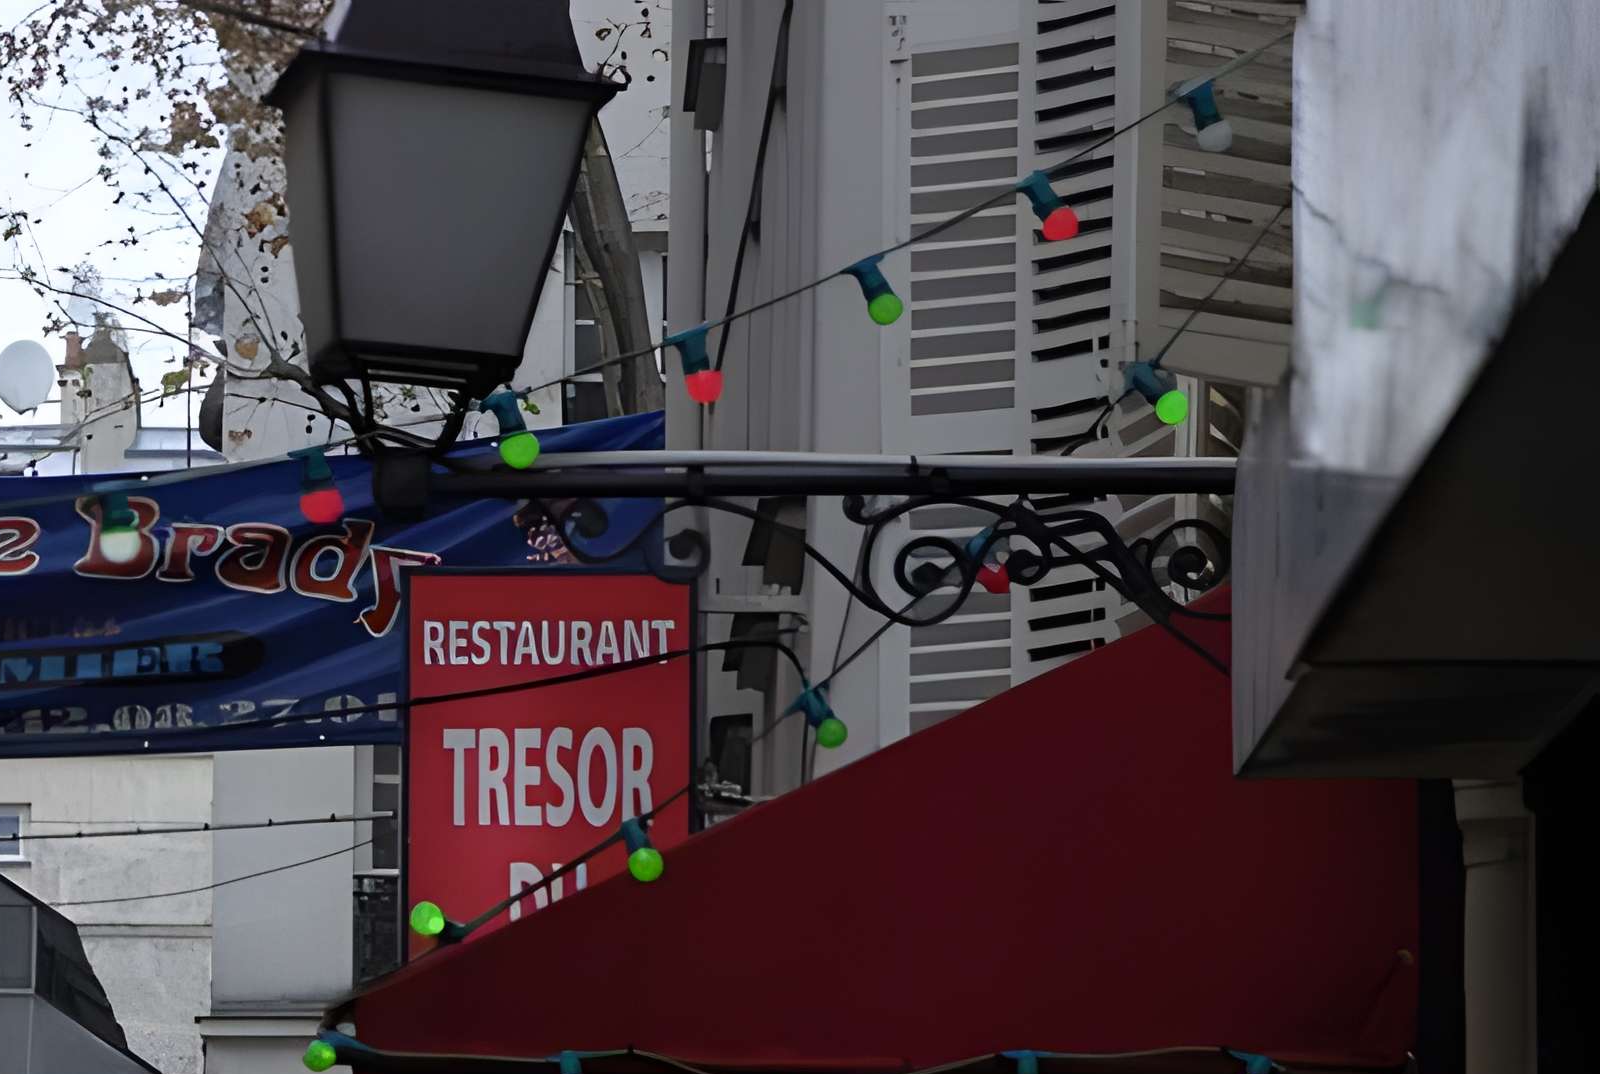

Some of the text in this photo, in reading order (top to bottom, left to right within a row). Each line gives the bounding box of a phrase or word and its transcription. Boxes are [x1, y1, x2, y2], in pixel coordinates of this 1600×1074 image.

[73, 495, 441, 637] Brady
[423, 620, 675, 665] RESTAURANT
[443, 727, 654, 827] TRESOR
